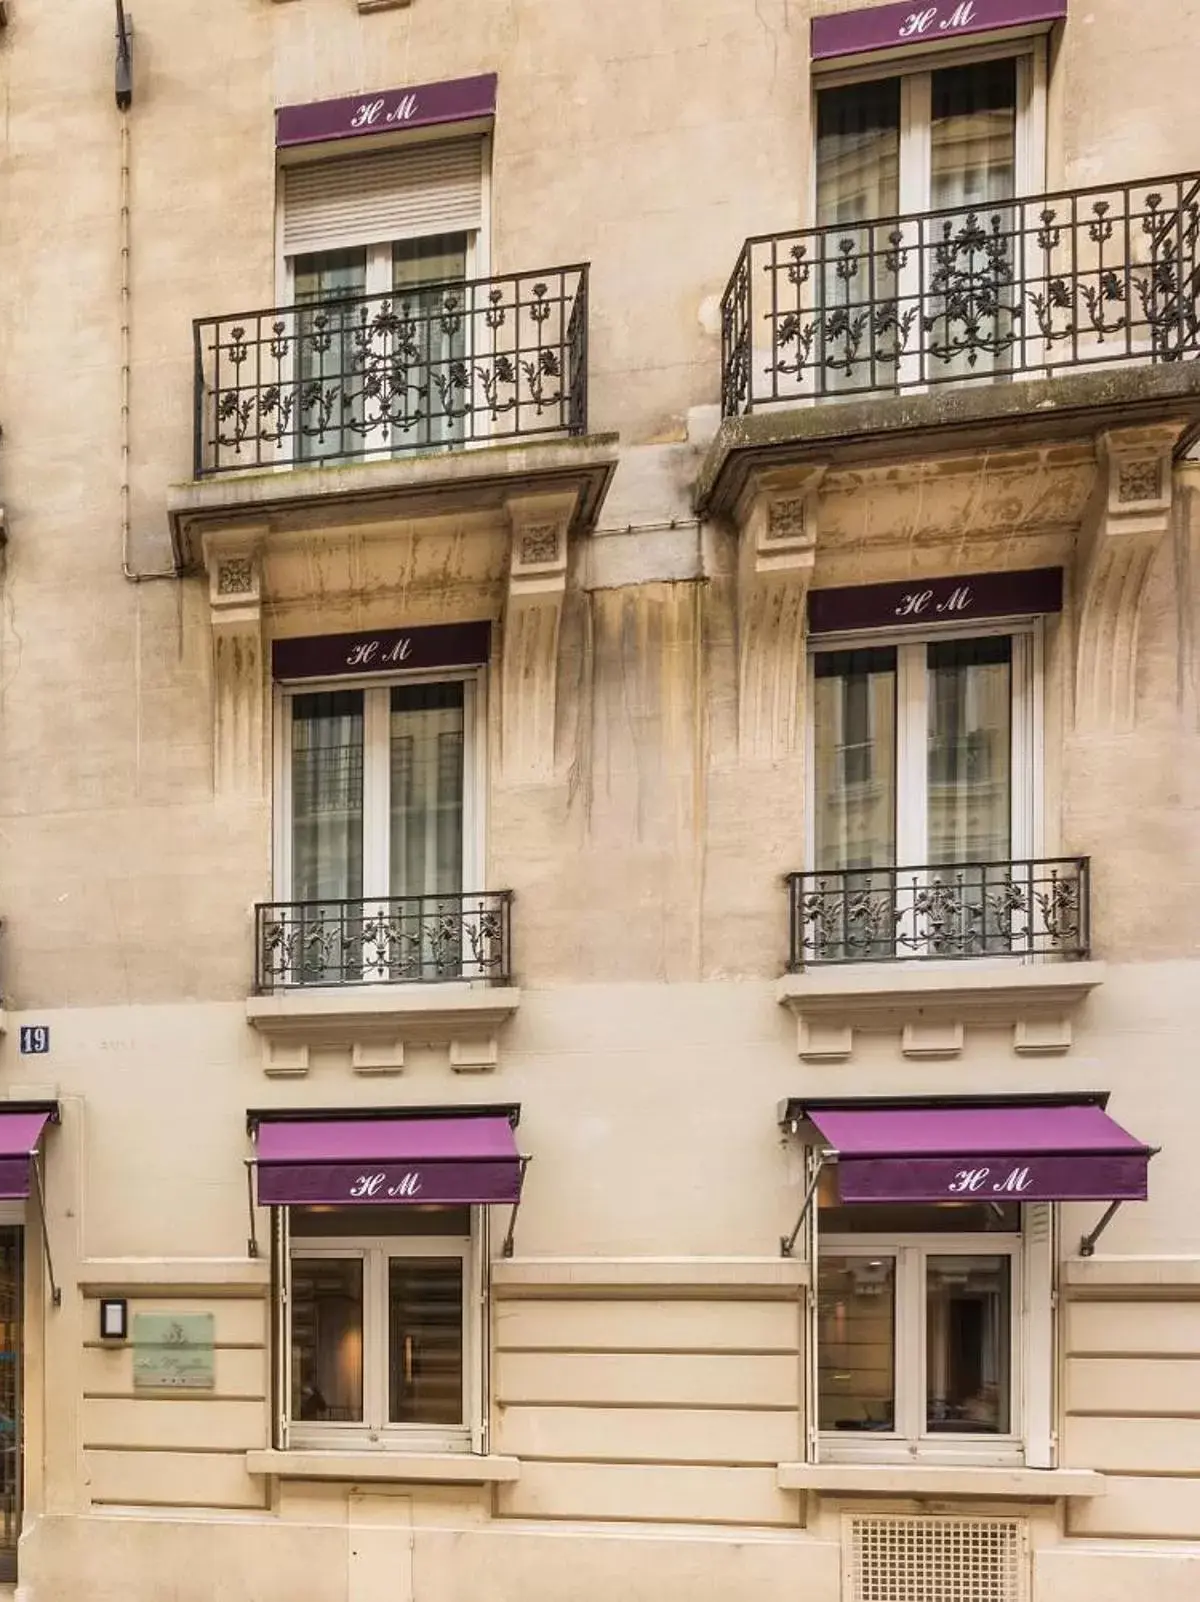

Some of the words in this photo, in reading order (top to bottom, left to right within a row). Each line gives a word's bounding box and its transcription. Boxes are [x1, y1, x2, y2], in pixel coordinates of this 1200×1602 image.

[899, 7, 937, 37] H
[938, 0, 978, 29] M
[351, 99, 385, 127] H
[387, 94, 419, 121] M
[896, 590, 934, 615] H
[937, 586, 973, 611] M
[347, 640, 380, 665] H
[382, 637, 412, 661] M
[24, 1029, 46, 1053] 19
[350, 1174, 387, 1197] H
[388, 1173, 421, 1196] M
[949, 1167, 990, 1192] H
[993, 1167, 1033, 1192] M
